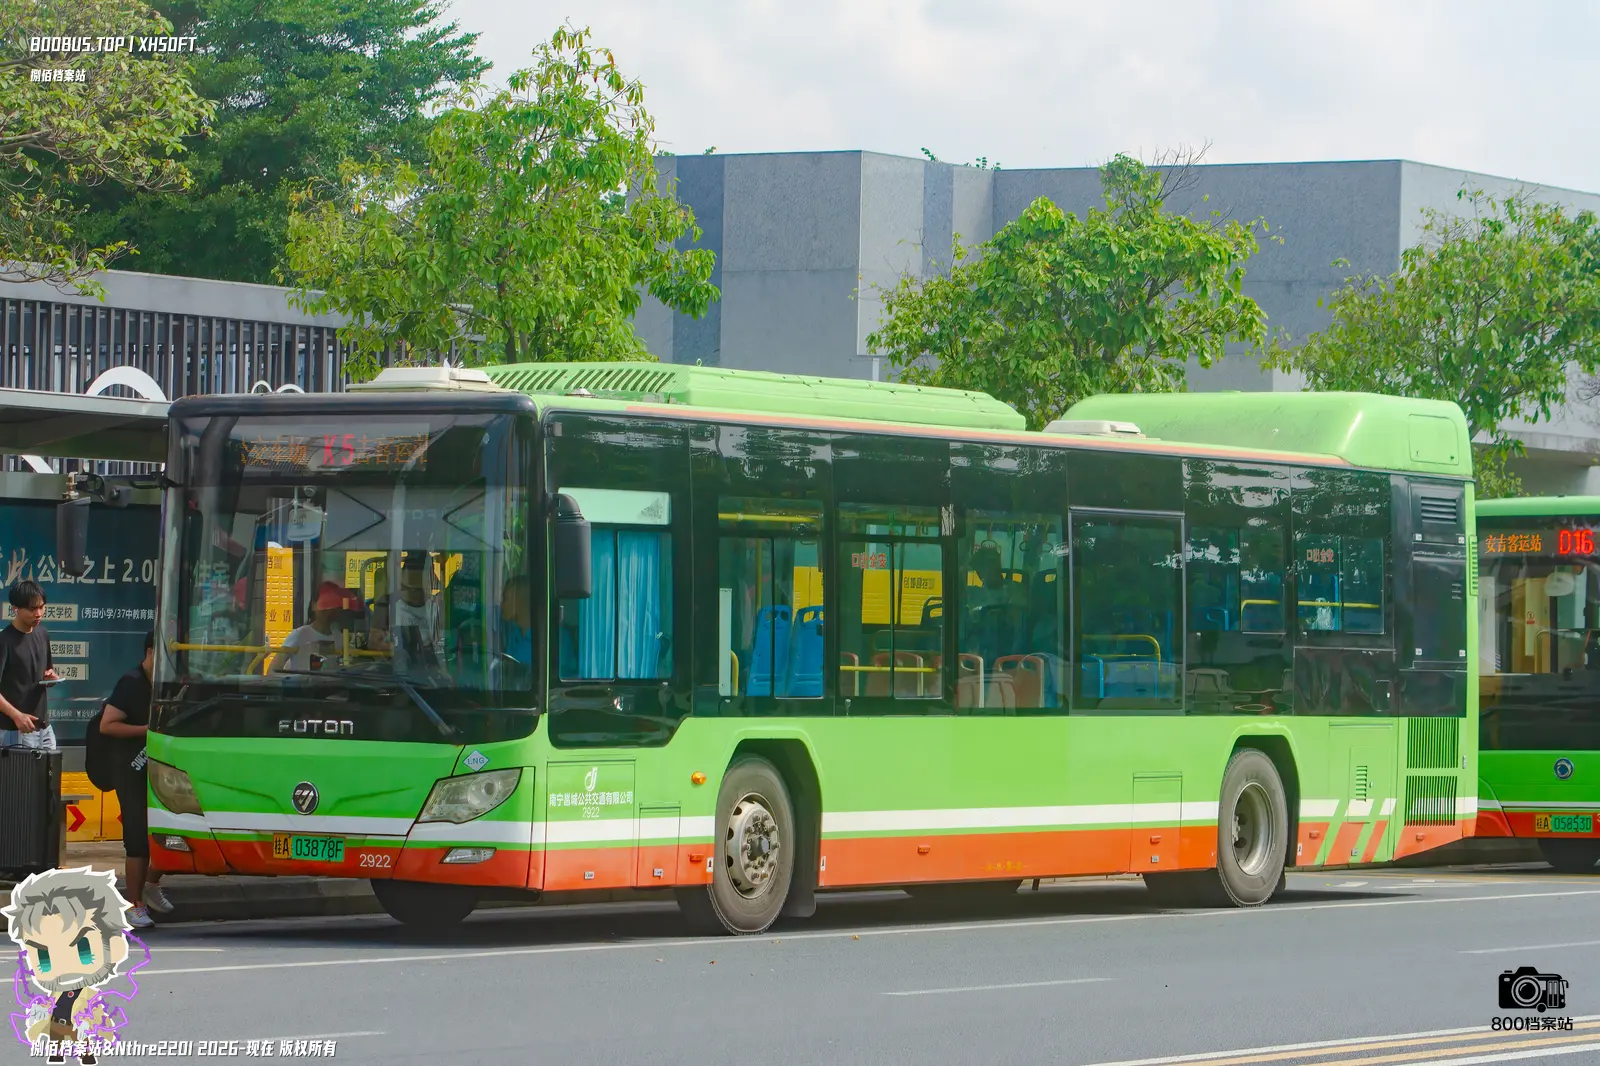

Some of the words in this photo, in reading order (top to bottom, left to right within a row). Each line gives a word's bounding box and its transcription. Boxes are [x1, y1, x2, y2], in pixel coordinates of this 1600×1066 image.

[323, 434, 355, 466] K5
[1485, 534, 1542, 553] 安吉客运站
[1559, 529, 1595, 555] D16
[122, 558, 157, 586] 2.0
[81, 607, 157, 620] (秀田小学/37中教育集
[278, 719, 354, 735] FOTON
[467, 756, 485, 765] LNG
[549, 791, 633, 807] 南宁邕城公共交通有限公司
[582, 807, 600, 818] 2922
[359, 853, 392, 868] 2922
